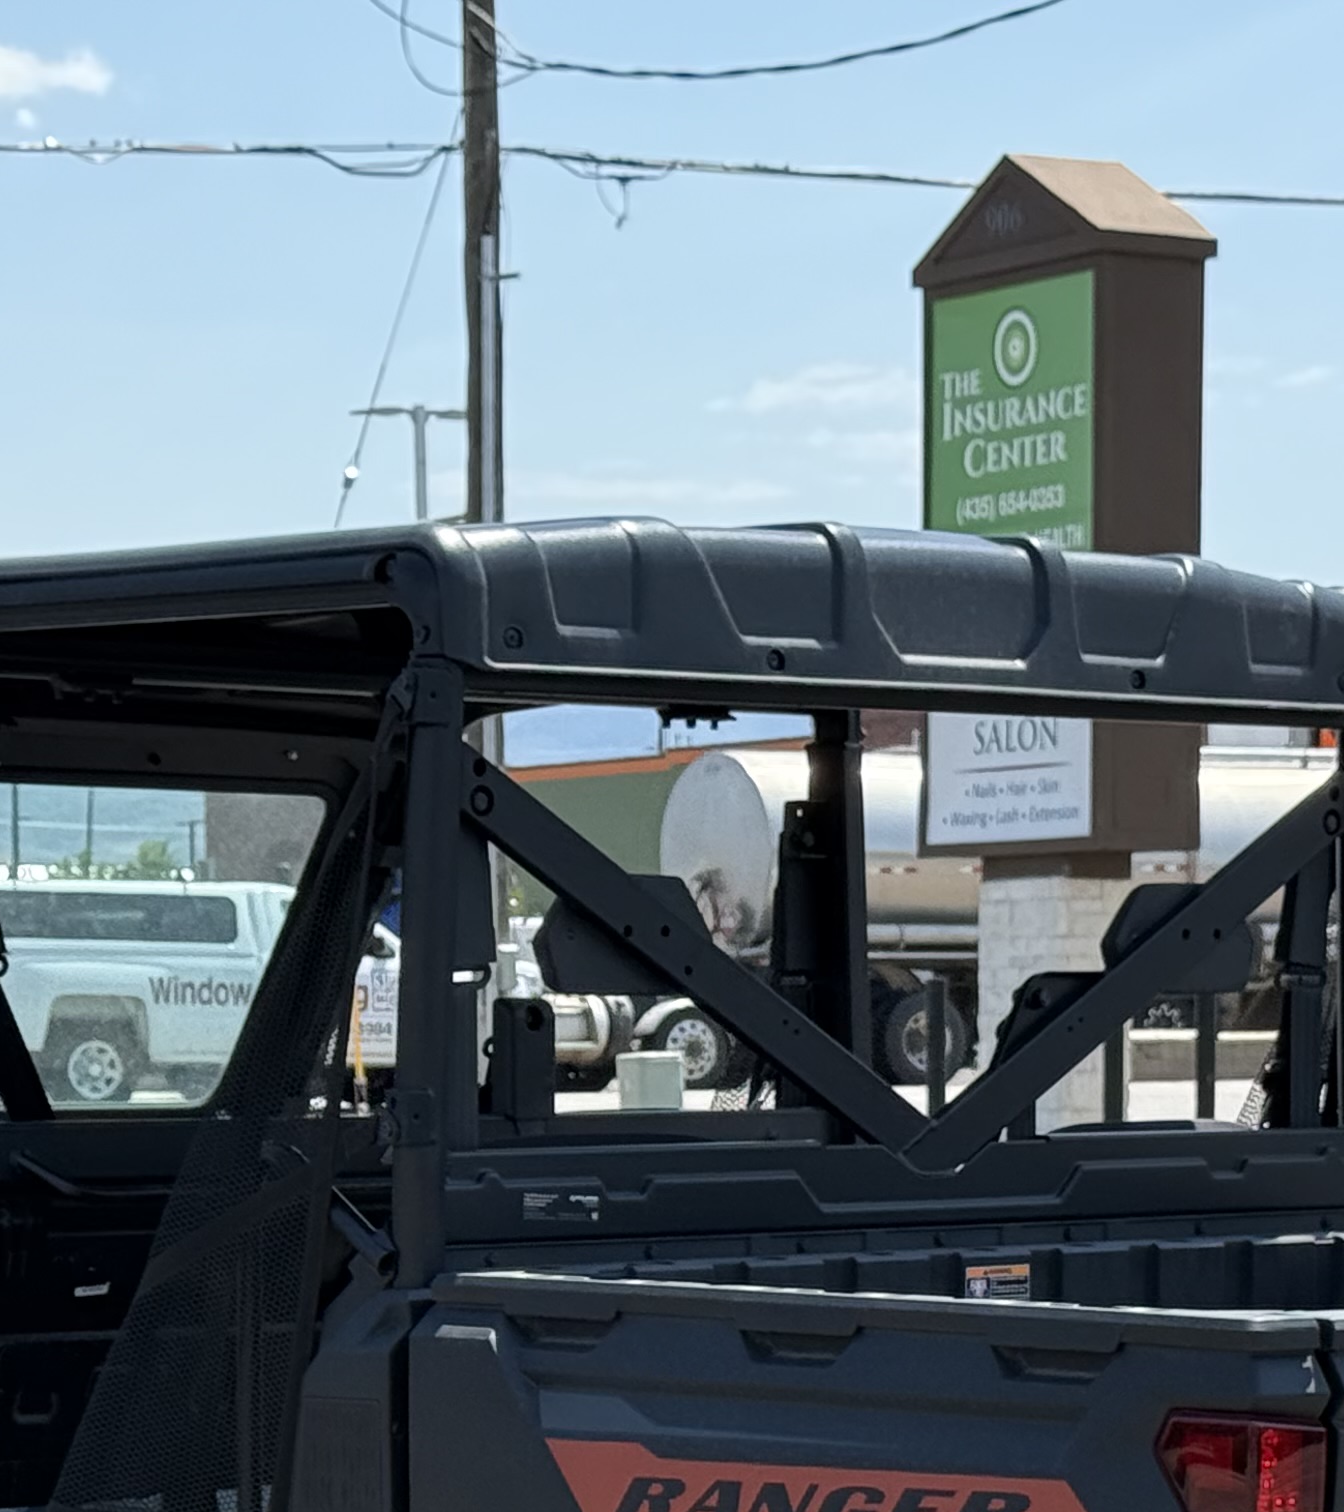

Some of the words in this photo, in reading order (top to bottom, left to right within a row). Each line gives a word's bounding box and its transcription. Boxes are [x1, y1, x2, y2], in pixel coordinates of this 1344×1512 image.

[942, 370, 981, 399] THE
[943, 385, 1087, 440] INSURANCE
[965, 431, 1066, 478] CENTER
[974, 718, 1058, 755] SALON
[148, 976, 252, 1005] Window
